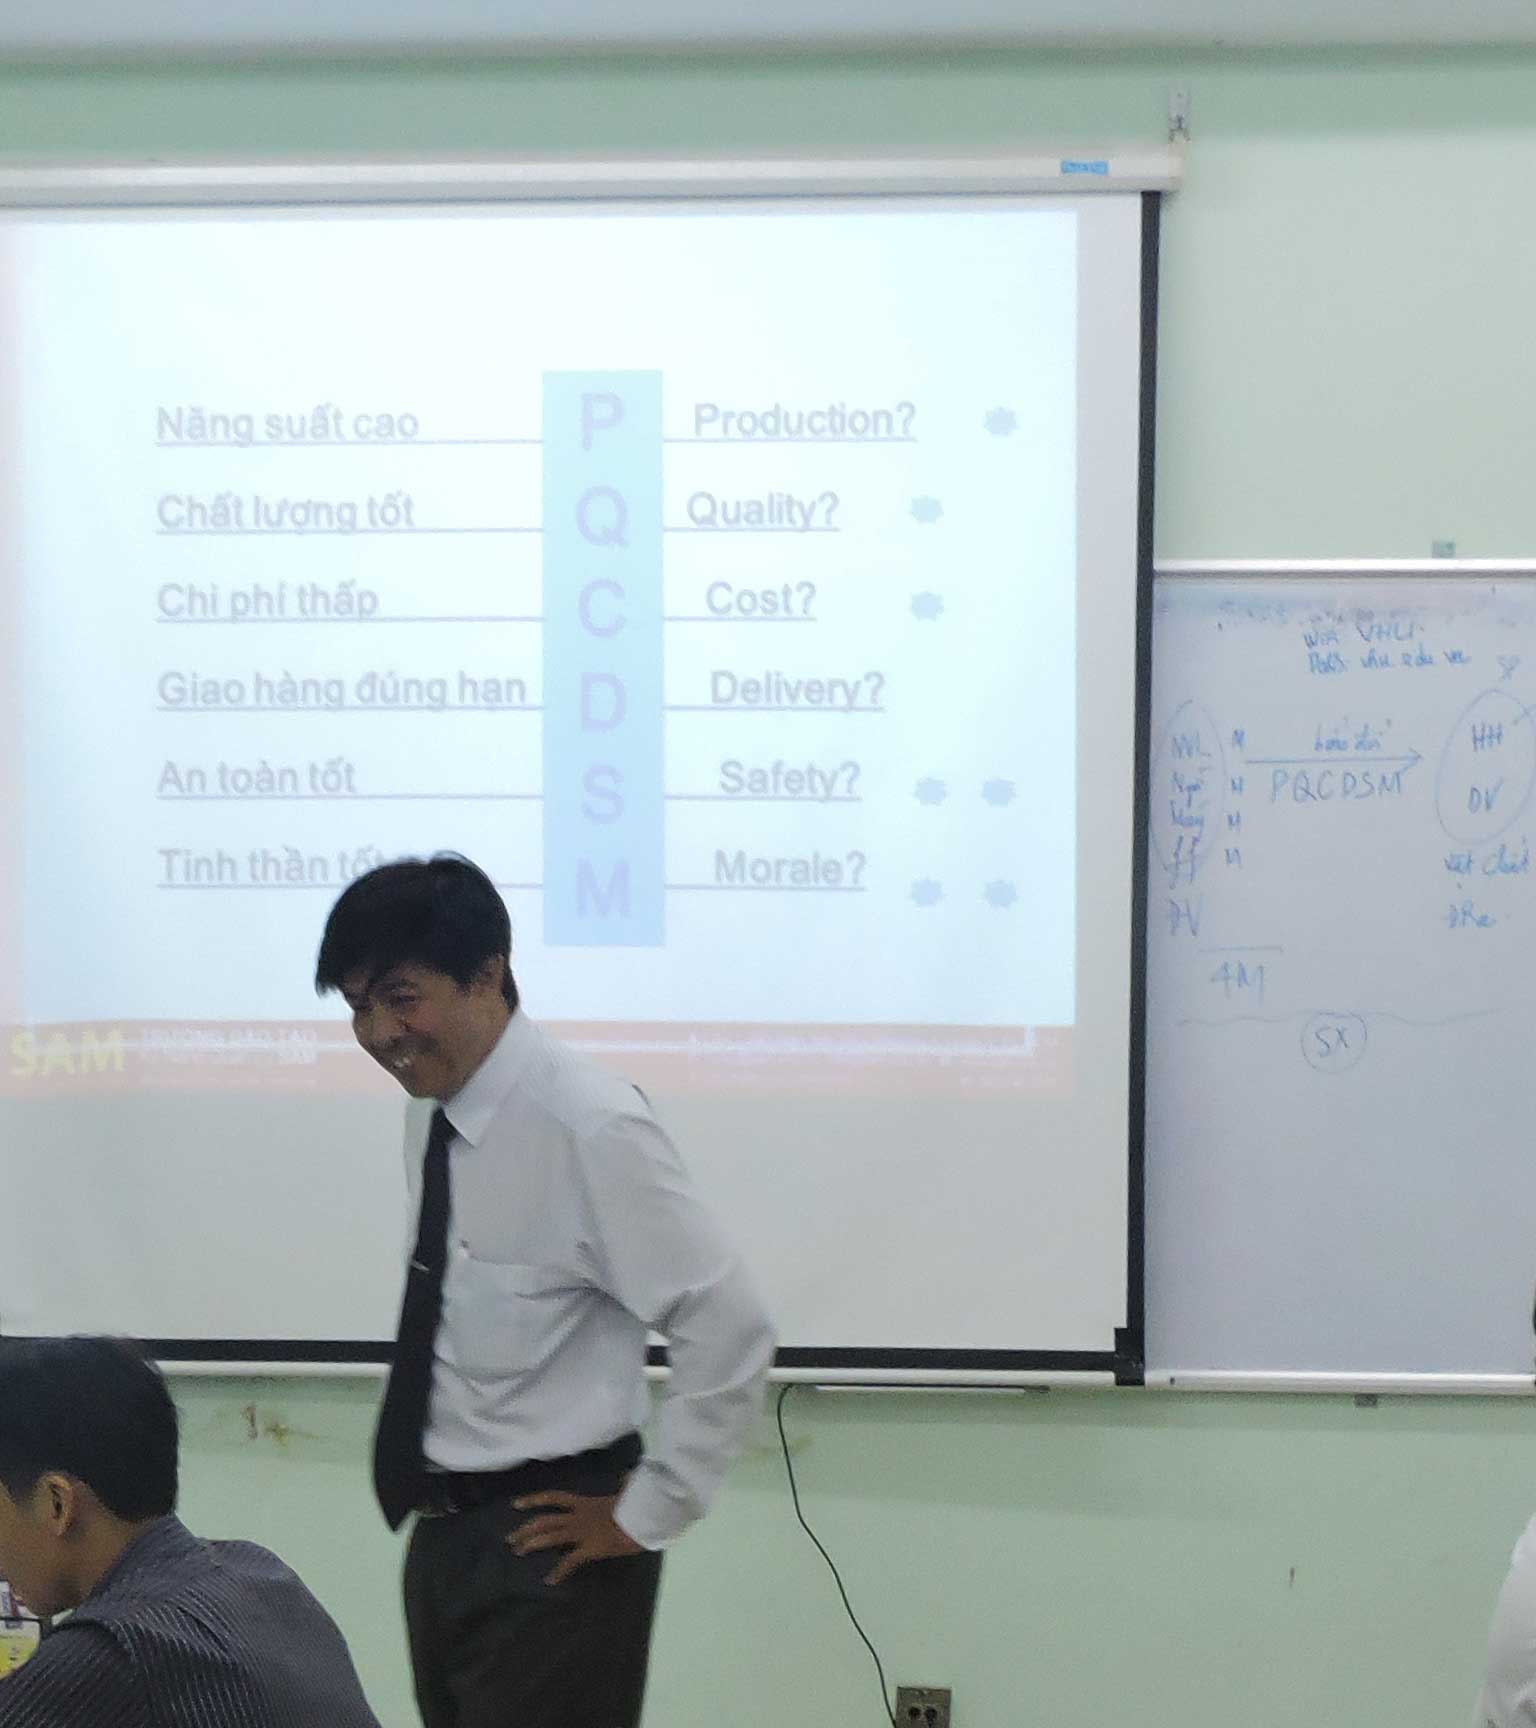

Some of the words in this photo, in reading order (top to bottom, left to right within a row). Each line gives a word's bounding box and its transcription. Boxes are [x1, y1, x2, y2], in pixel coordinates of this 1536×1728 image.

[157, 405, 254, 446] Năng
[264, 402, 345, 439] suất
[353, 412, 419, 439] cao
[580, 393, 624, 452] P
[694, 402, 917, 438] Production?
[157, 491, 244, 528] Chất
[253, 496, 357, 534] lượng
[366, 489, 415, 527] tốt
[575, 486, 630, 547] Q
[686, 491, 840, 531] Quality?
[157, 583, 219, 616] Chi
[230, 580, 287, 622] phí
[298, 578, 380, 622] thấp
[578, 579, 628, 639] C
[705, 581, 817, 617] Cost?
[157, 672, 246, 706] Giao
[254, 670, 347, 710] hàng
[354, 670, 448, 710] đúng
[458, 672, 526, 710] hạn
[580, 672, 627, 732] D
[711, 670, 886, 711] Delivery?
[157, 761, 208, 795] An
[217, 760, 299, 795] toàn
[306, 754, 356, 795] tốt
[581, 764, 626, 825] S
[719, 761, 862, 801] Safety?
[158, 849, 239, 882] Tinh
[248, 846, 329, 882] thần
[714, 850, 867, 887] Morale?
[575, 861, 630, 918] M
[10, 1027, 126, 1078] SAM
